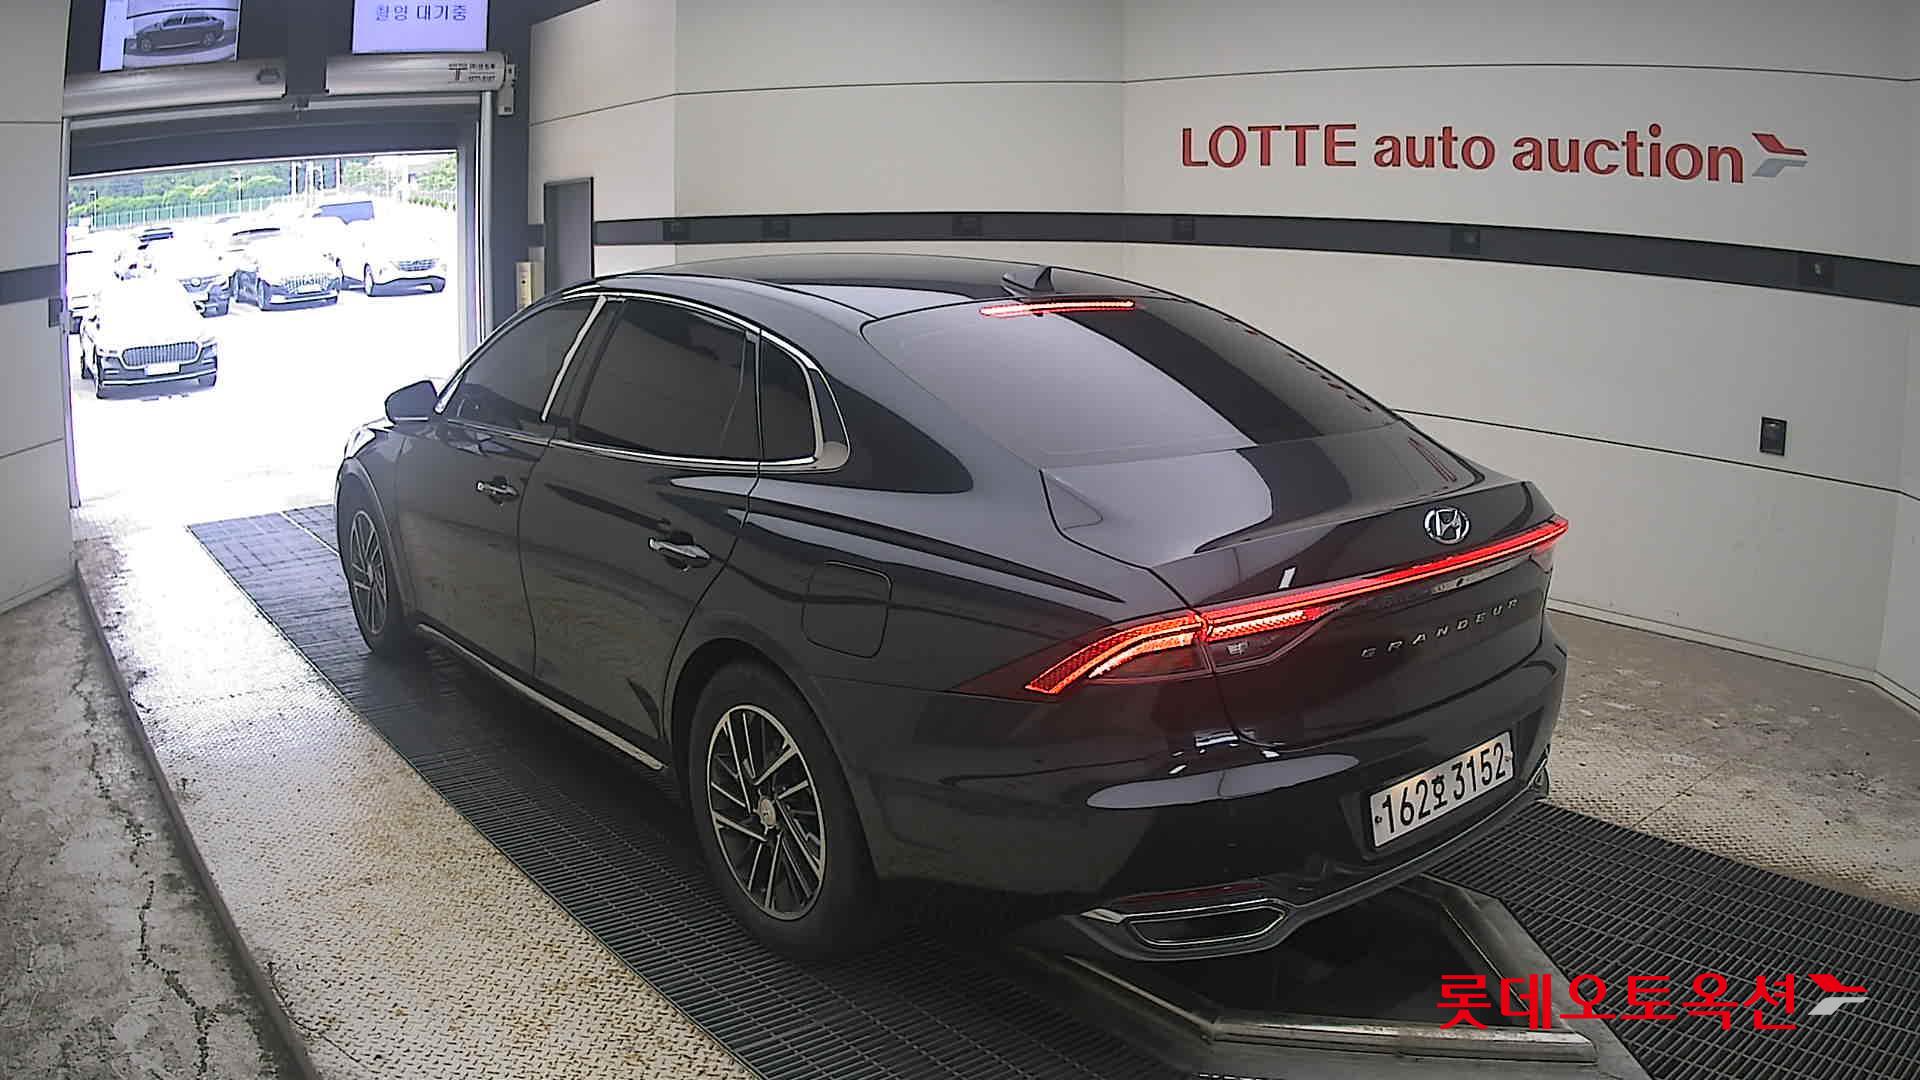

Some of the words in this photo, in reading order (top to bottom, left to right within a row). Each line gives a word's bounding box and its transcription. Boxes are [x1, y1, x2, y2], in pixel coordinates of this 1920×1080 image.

[416, 5, 467, 21] 대기중
[1182, 124, 1357, 168] LOTTE
[1374, 127, 1496, 170] auto
[1512, 123, 1744, 184] auction
[1361, 599, 1518, 658] GRANDEUR
